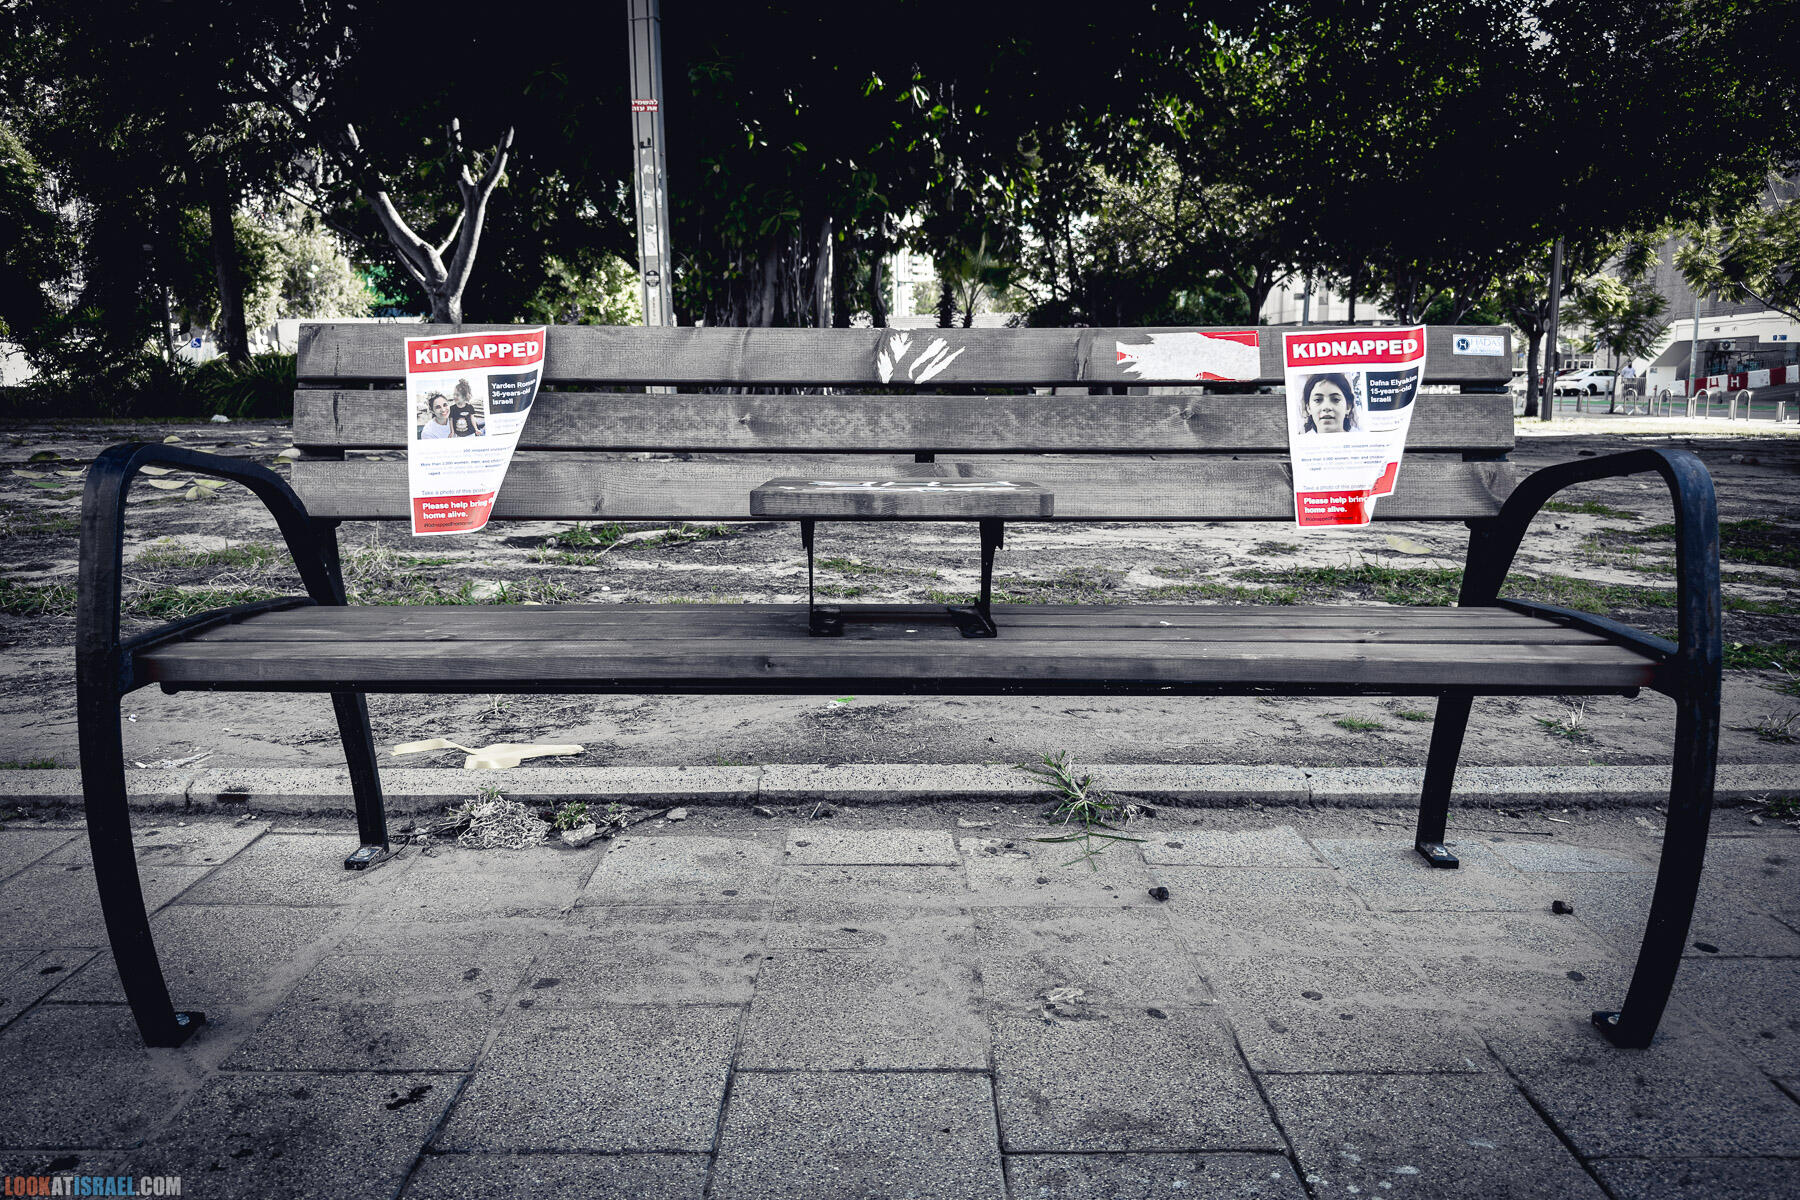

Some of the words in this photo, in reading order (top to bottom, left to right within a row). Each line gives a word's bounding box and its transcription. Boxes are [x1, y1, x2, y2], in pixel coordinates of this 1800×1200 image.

[416, 341, 539, 364] KIDNAPPED
[1293, 339, 1418, 358] KIDNAPPED
[492, 388, 531, 398] 36-years-old
[1370, 384, 1412, 395] 15-years-old
[422, 502, 449, 510] Please
[451, 501, 468, 509] help
[1330, 497, 1347, 505] help
